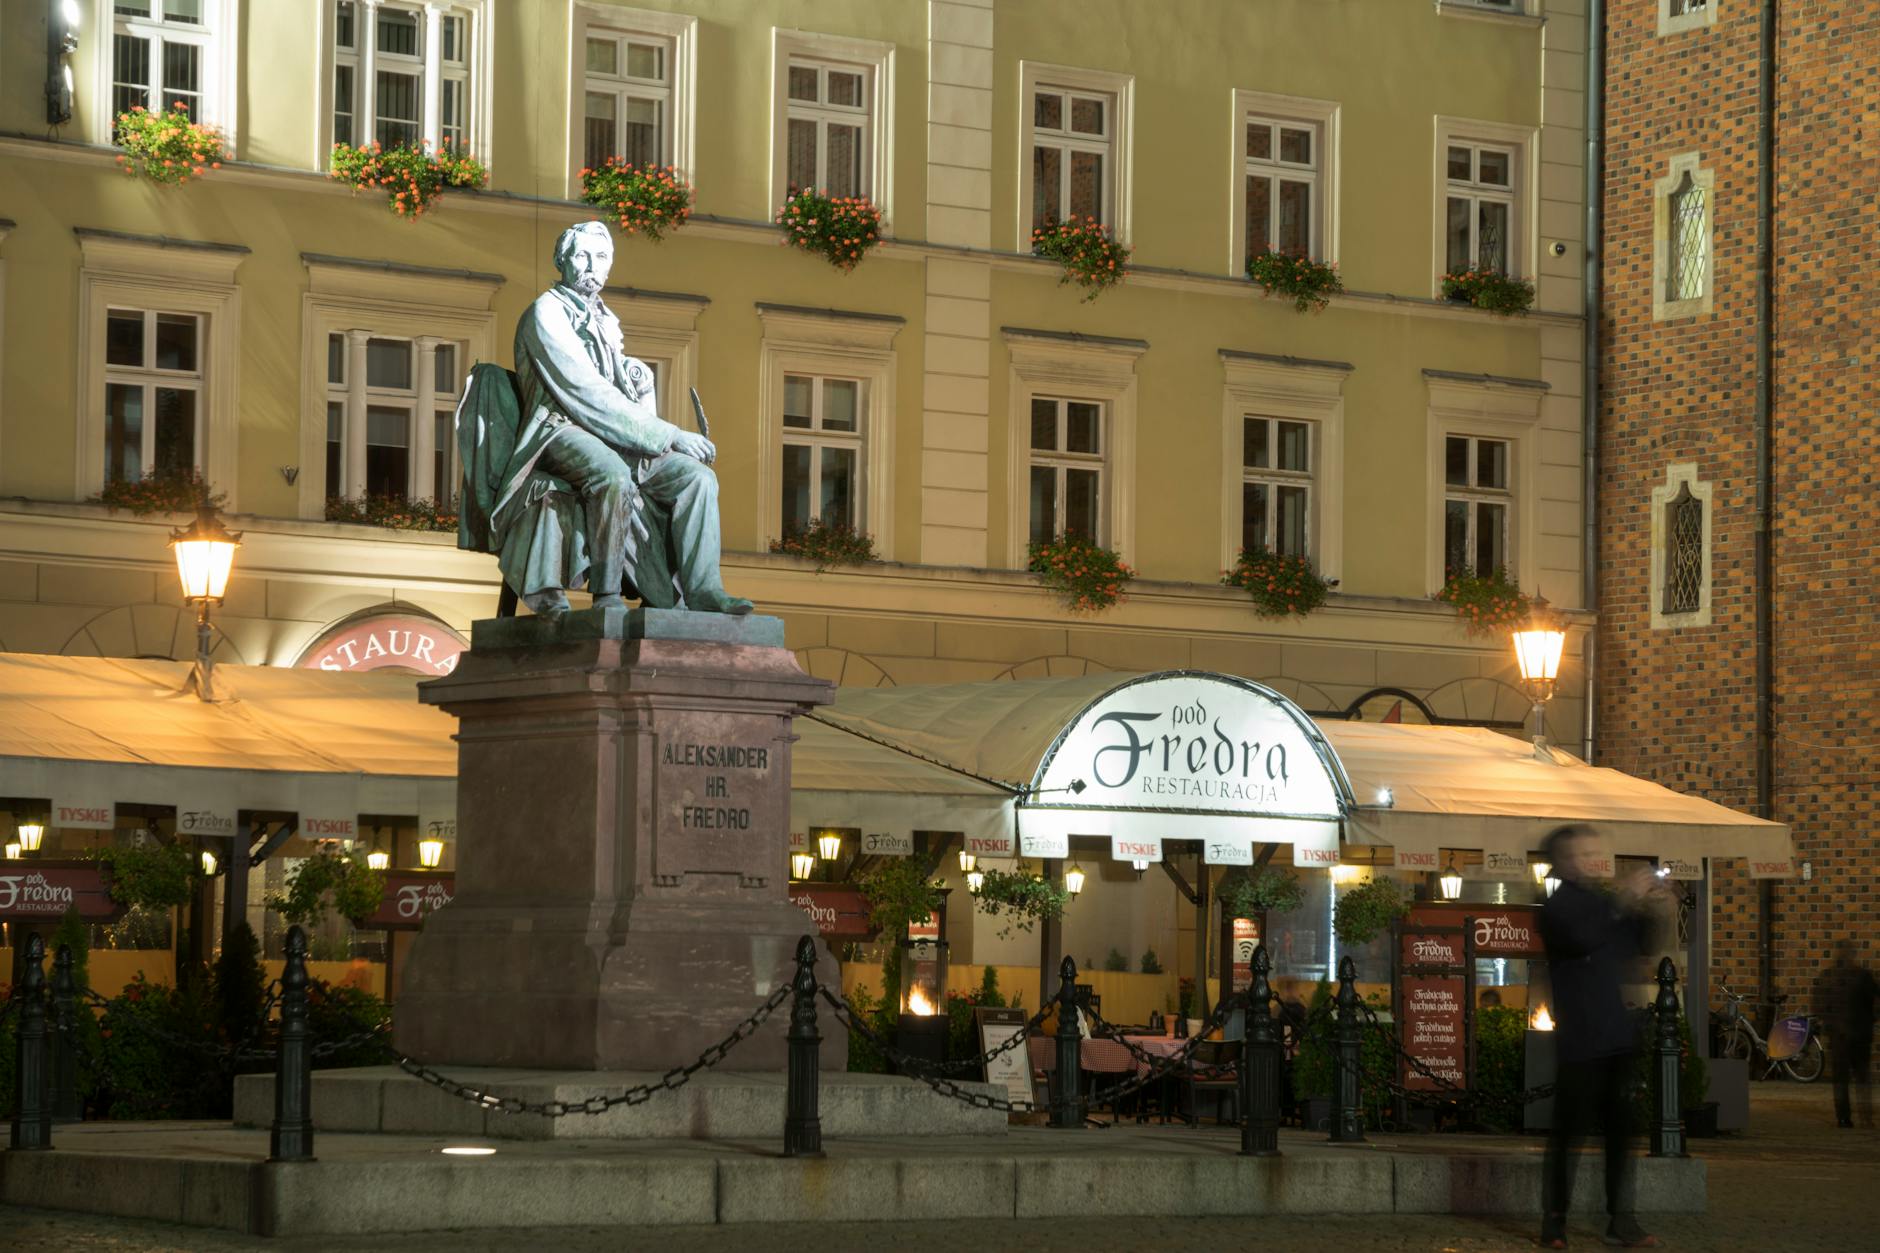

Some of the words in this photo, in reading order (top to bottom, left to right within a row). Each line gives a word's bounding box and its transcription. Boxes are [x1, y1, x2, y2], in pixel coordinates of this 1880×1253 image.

[319, 630, 461, 676] STAURA
[1173, 697, 1206, 729] pod
[663, 743, 768, 769] ALEKSANDER
[705, 775, 730, 798] HR.
[1143, 776, 1278, 802] RESTAURACJA
[57, 807, 109, 823] TYSKIE
[683, 806, 749, 829] FREDRO
[305, 817, 353, 834] TYSKIE
[970, 838, 1010, 852] TYSKIE
[1118, 842, 1157, 856] TYSKIE
[1302, 848, 1339, 862] TYSKIE
[1400, 853, 1436, 866] TYSKIE
[1753, 862, 1790, 874] TYSKIE
[26, 872, 44, 885] pod
[16, 903, 70, 912] RESTAURACJ
[397, 885, 455, 918] Fred
[1490, 941, 1529, 950] RESTAURACJA
